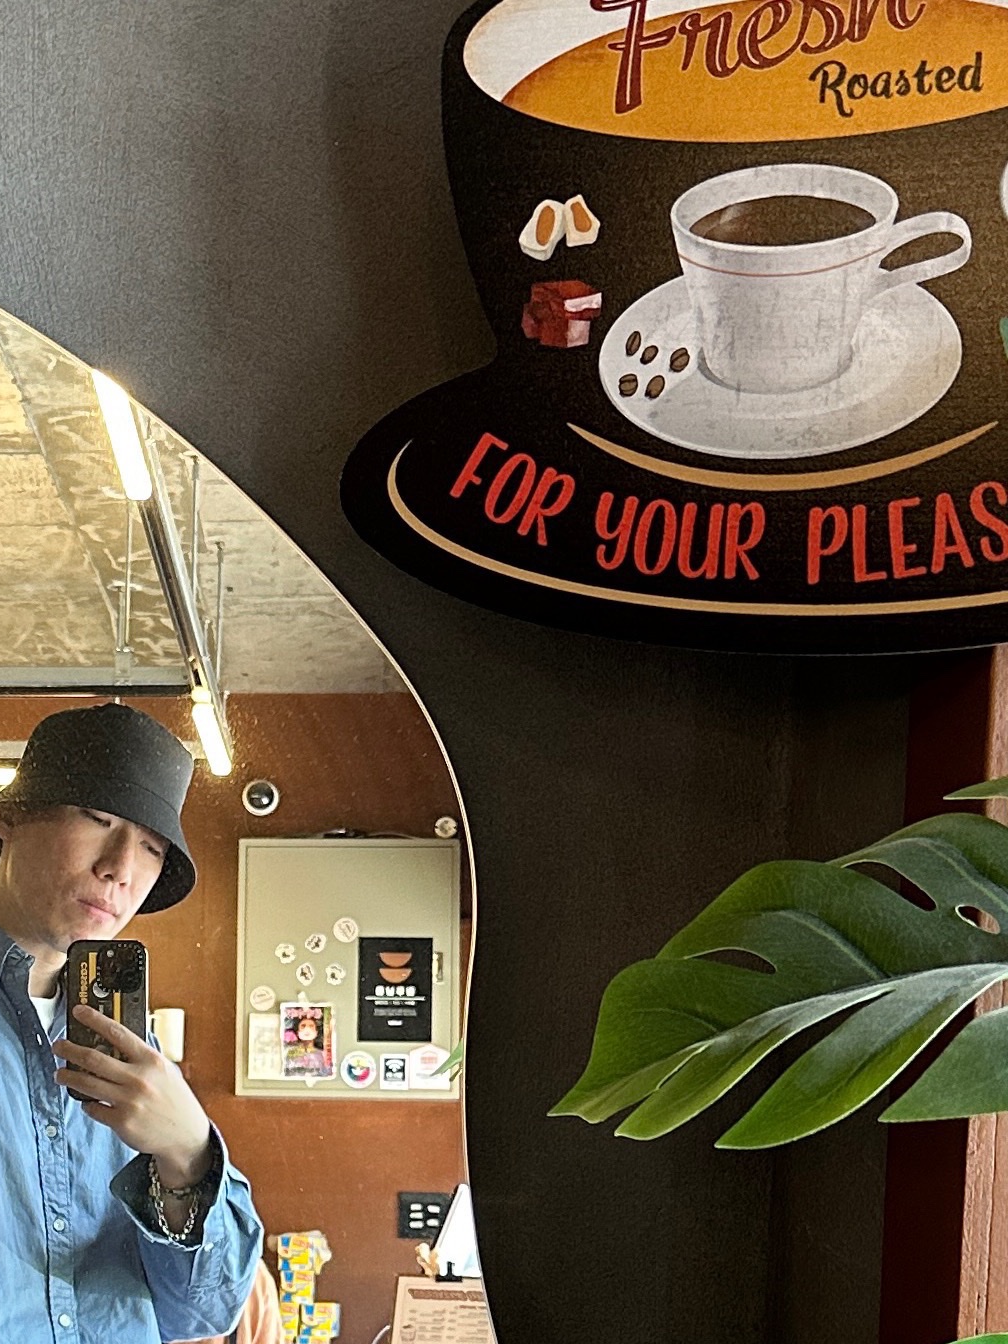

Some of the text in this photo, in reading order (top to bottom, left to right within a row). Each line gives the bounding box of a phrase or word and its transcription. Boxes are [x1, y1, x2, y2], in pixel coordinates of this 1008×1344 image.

[808, 51, 984, 118] Roasted
[448, 432, 576, 546] FOR
[595, 491, 766, 581] YOUR
